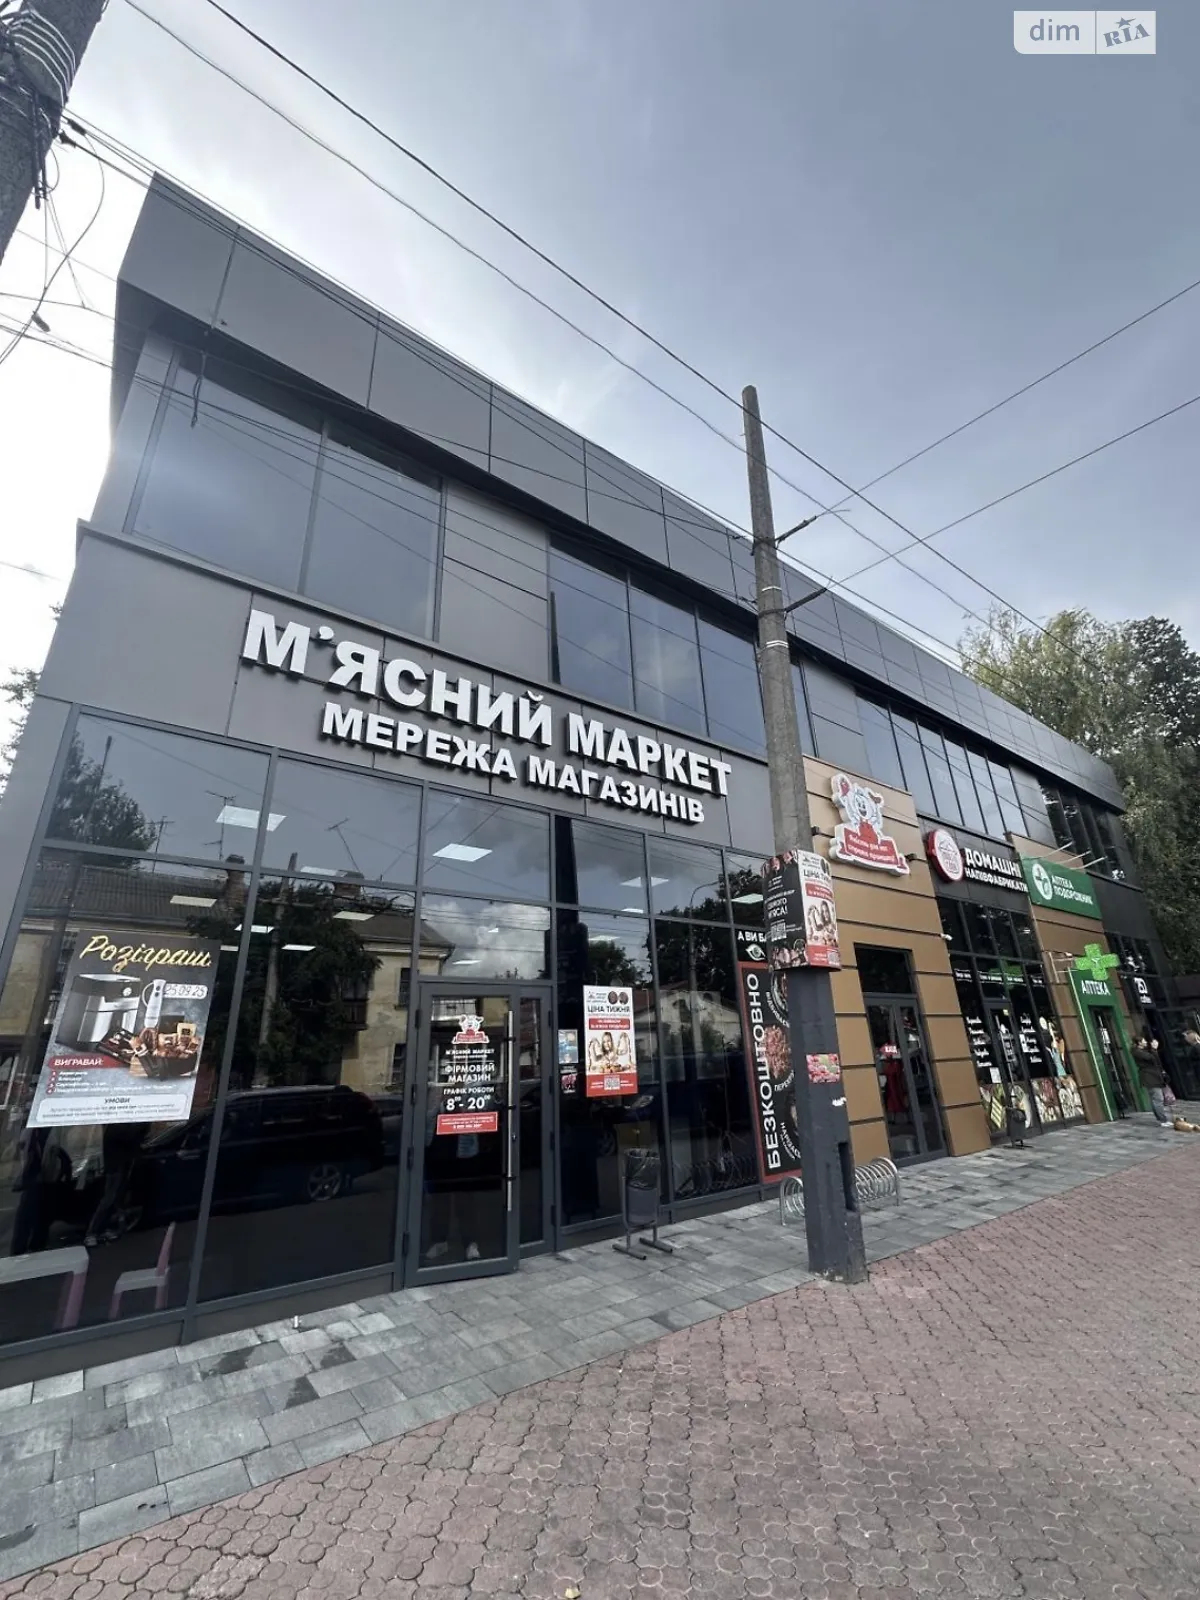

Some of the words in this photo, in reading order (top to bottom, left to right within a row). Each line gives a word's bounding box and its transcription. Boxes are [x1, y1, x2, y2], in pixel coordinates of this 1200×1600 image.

[321, 702, 518, 780] МЕРЕЖА
[528, 754, 705, 824] МАГАЗИНІВ
[566, 711, 733, 797] МАРКЕТ
[964, 847, 1024, 879] ДОМАШНІ
[1052, 875, 1074, 890] АПТЕКА
[79, 935, 212, 973] Розіграш
[1081, 979, 1111, 996] АПТЕКА
[444, 1062, 495, 1073] ФІРМОВИЙ
[447, 1073, 491, 1083] МАГАЗИН
[746, 973, 782, 1169] БЕЗКОШТОВНО
[468, 1086, 495, 1094] РОБОТИ
